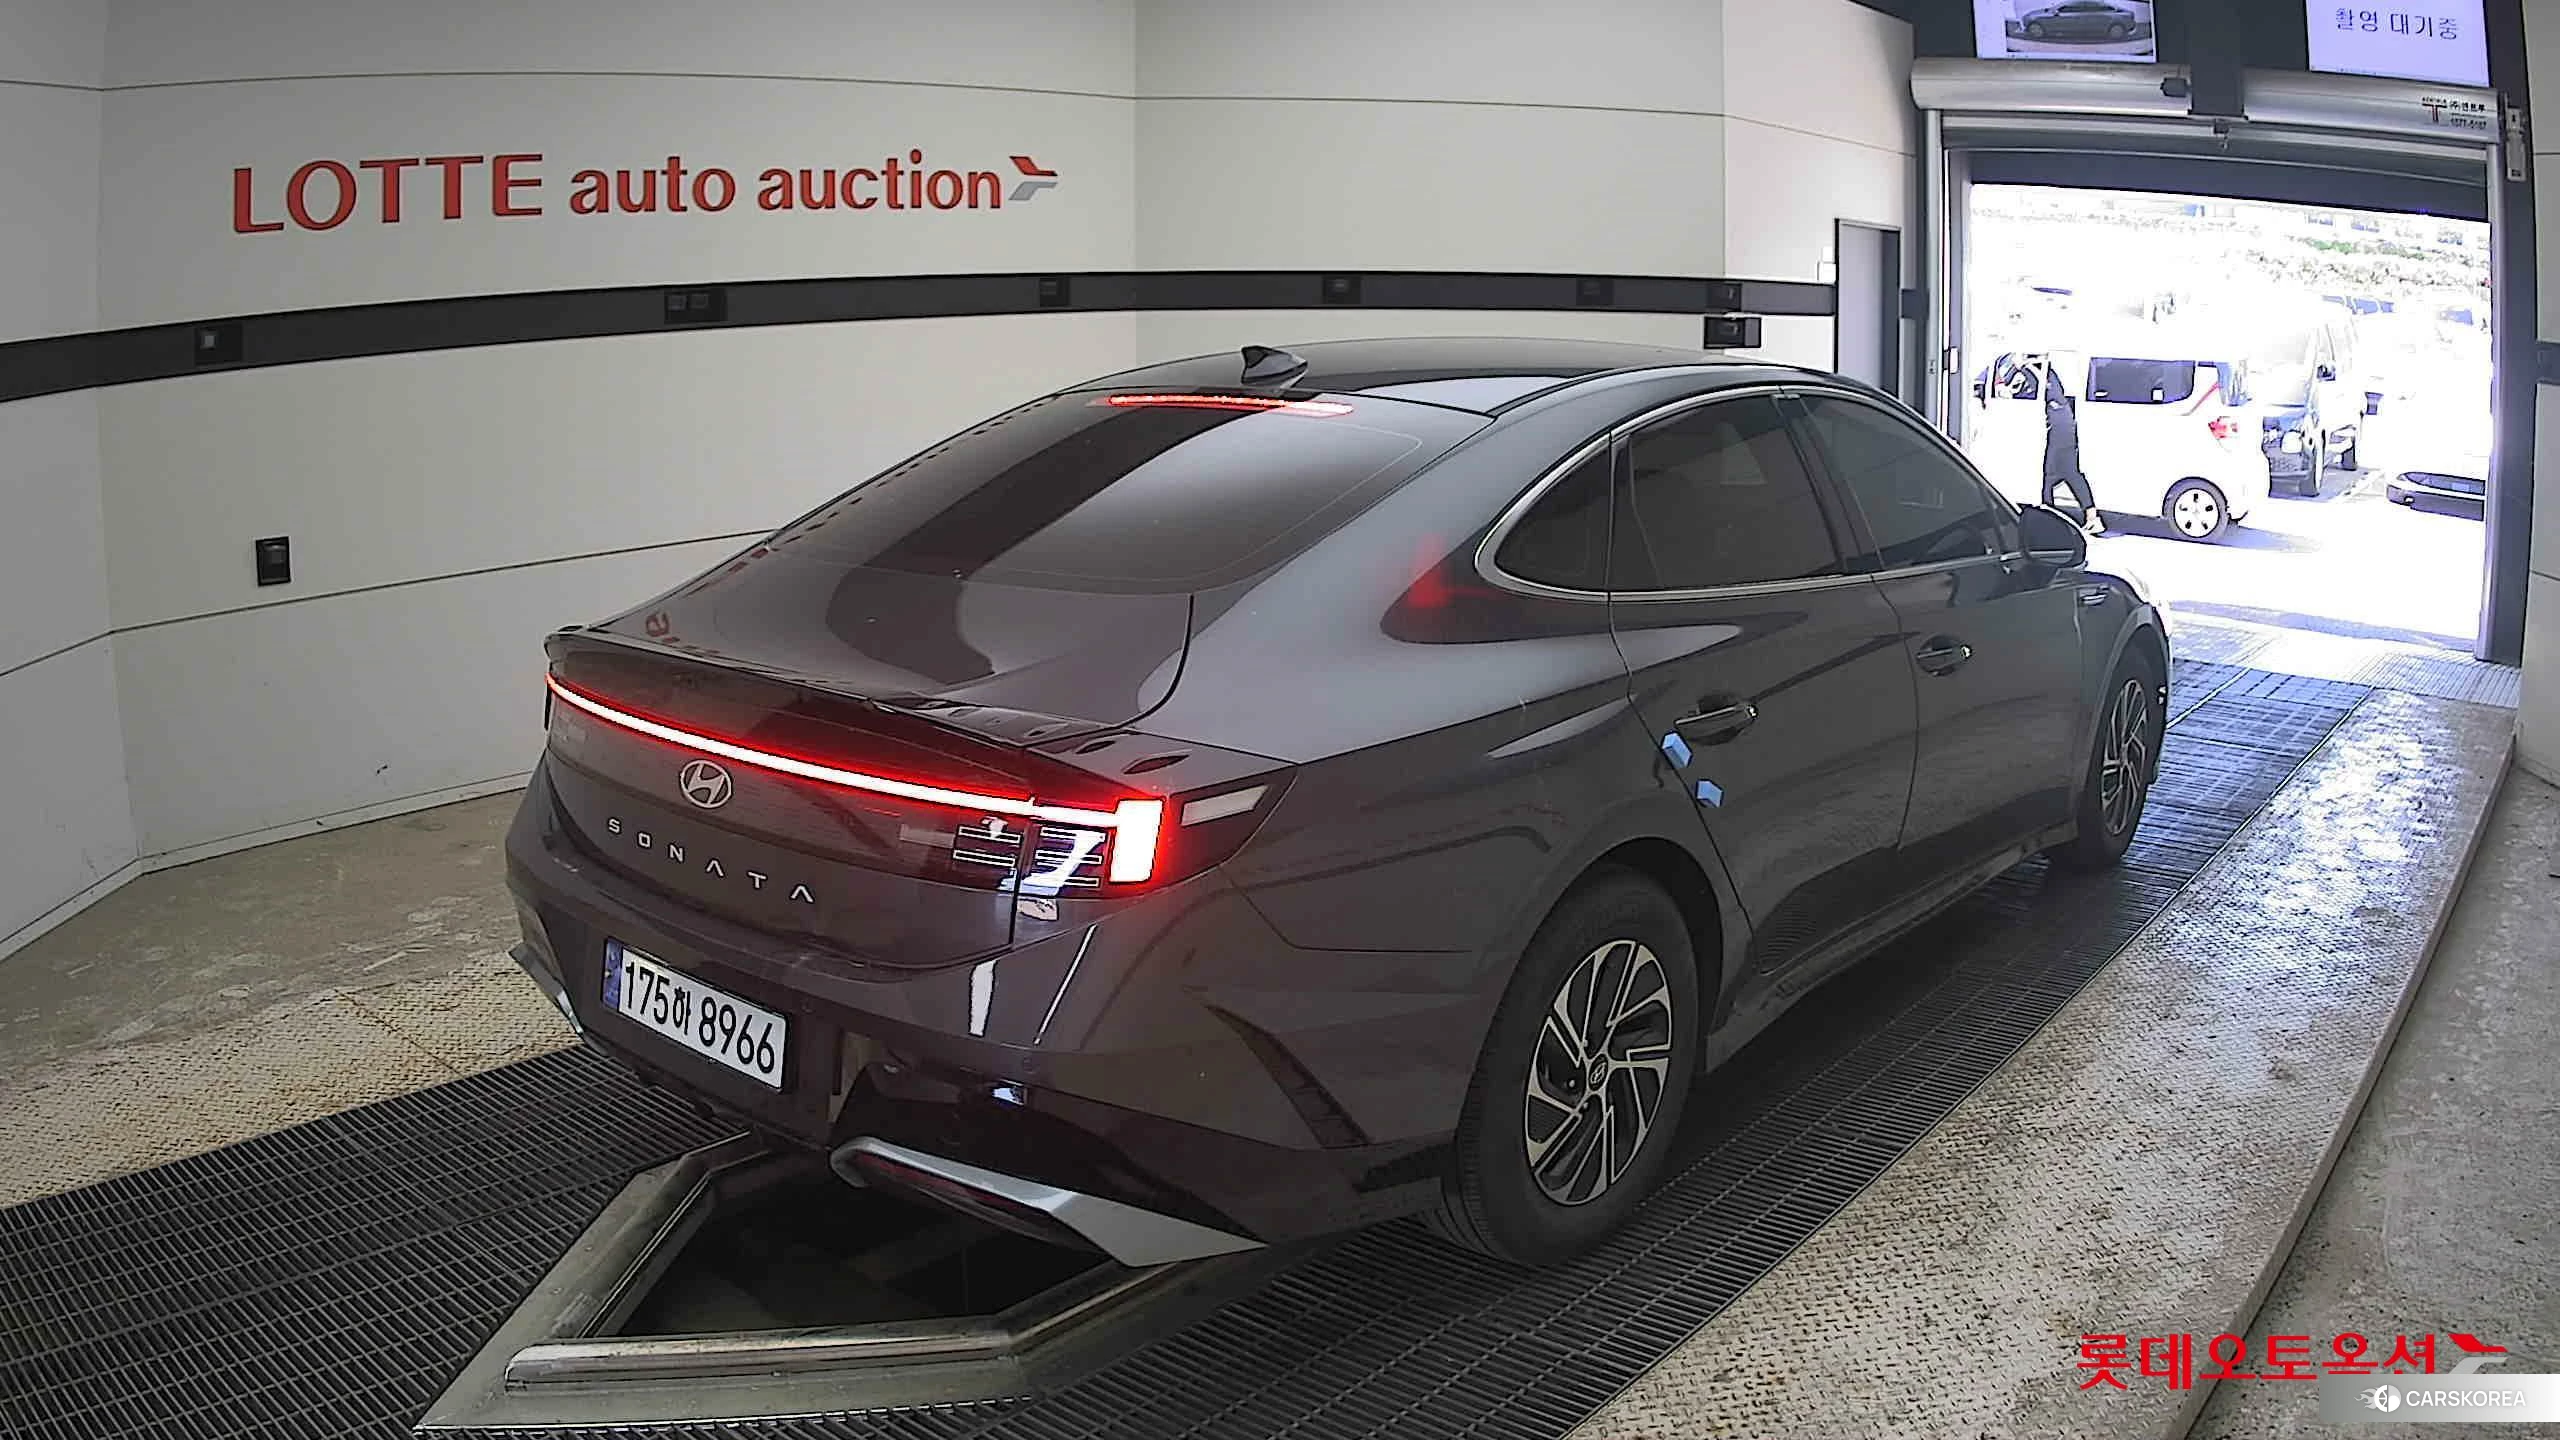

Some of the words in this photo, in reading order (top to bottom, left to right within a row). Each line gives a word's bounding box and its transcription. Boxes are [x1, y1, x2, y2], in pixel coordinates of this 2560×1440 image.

[2335, 8, 2378, 32] 촬영
[234, 154, 543, 233] LOTTE
[569, 156, 736, 214] auto
[757, 149, 1002, 211] auction
[608, 818, 814, 904] SONATA
[625, 962, 691, 1036] 175하
[699, 996, 775, 1074] 8966
